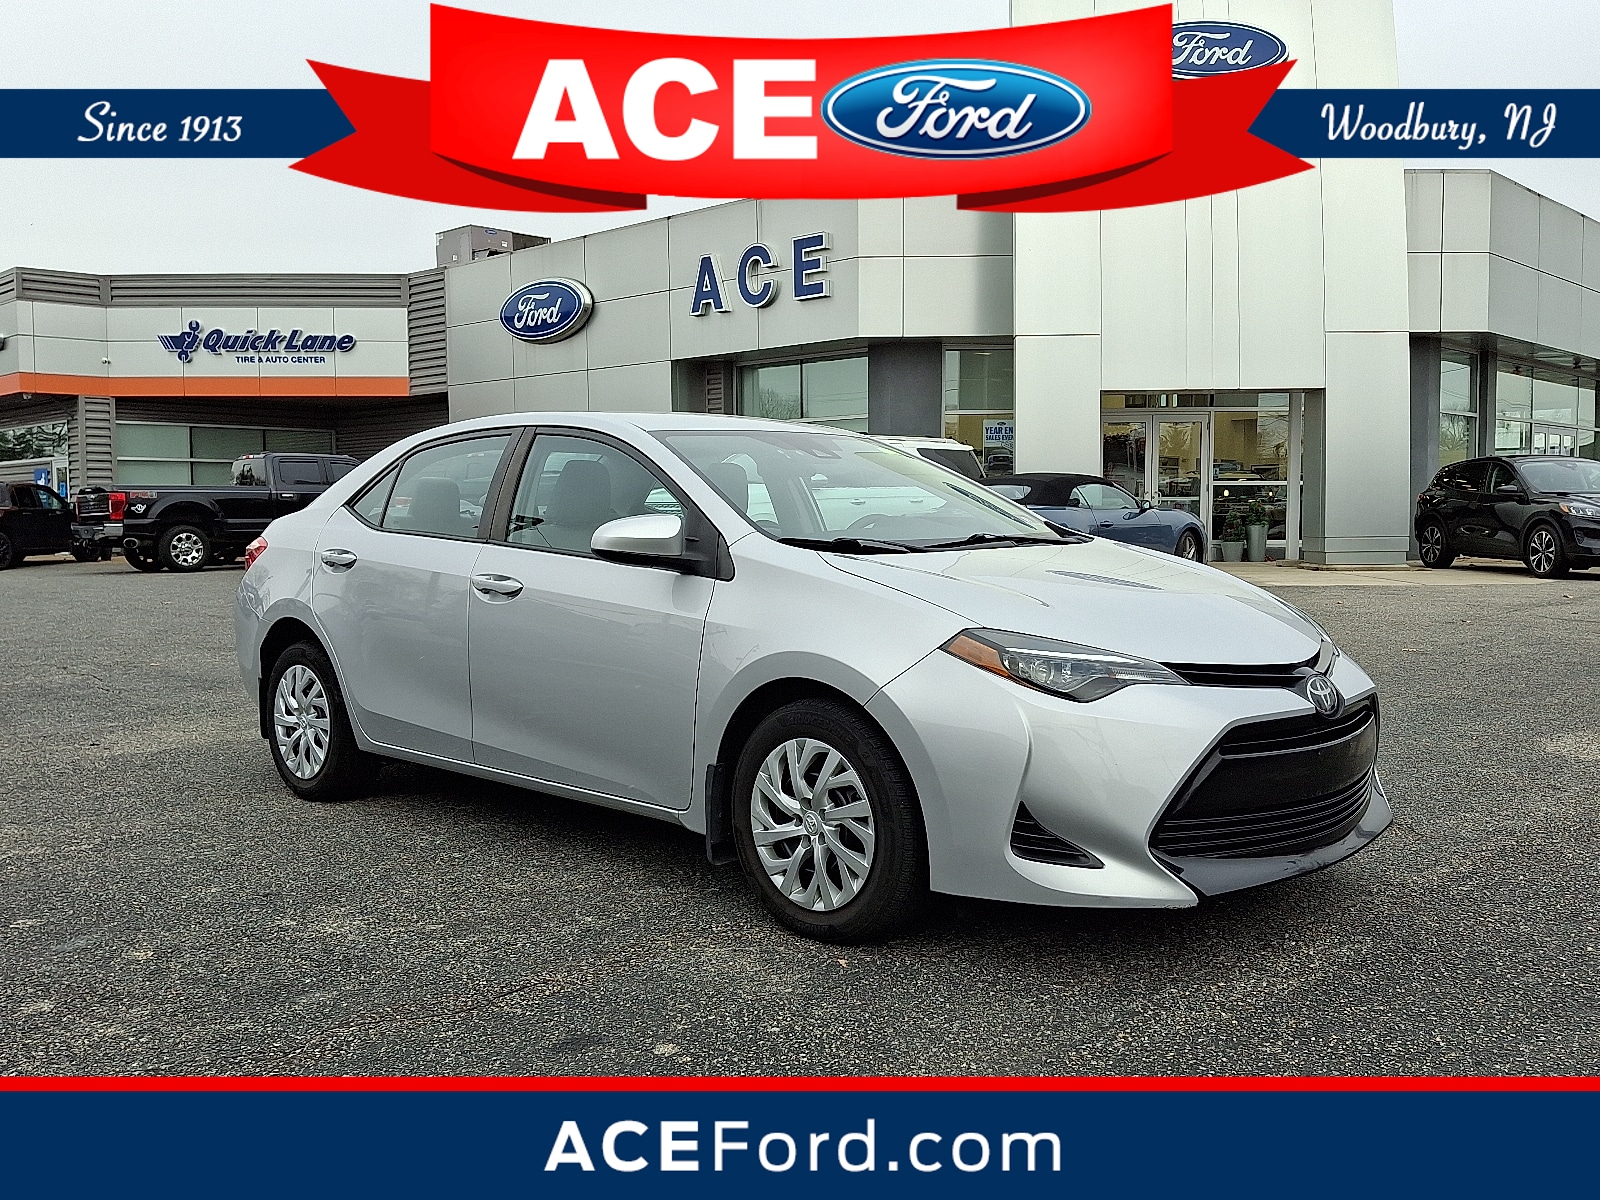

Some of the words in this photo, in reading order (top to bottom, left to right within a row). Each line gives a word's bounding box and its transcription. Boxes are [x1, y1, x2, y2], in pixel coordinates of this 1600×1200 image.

[1171, 30, 1254, 66] Ford
[689, 231, 831, 317] ACE
[513, 292, 562, 329] Ford
[202, 328, 284, 355] Quick
[284, 329, 356, 352] Lane
[235, 355, 256, 364] TIRE
[265, 355, 289, 364] AUTO
[290, 355, 326, 364] CENTER
[985, 426, 1003, 434] YEAR
